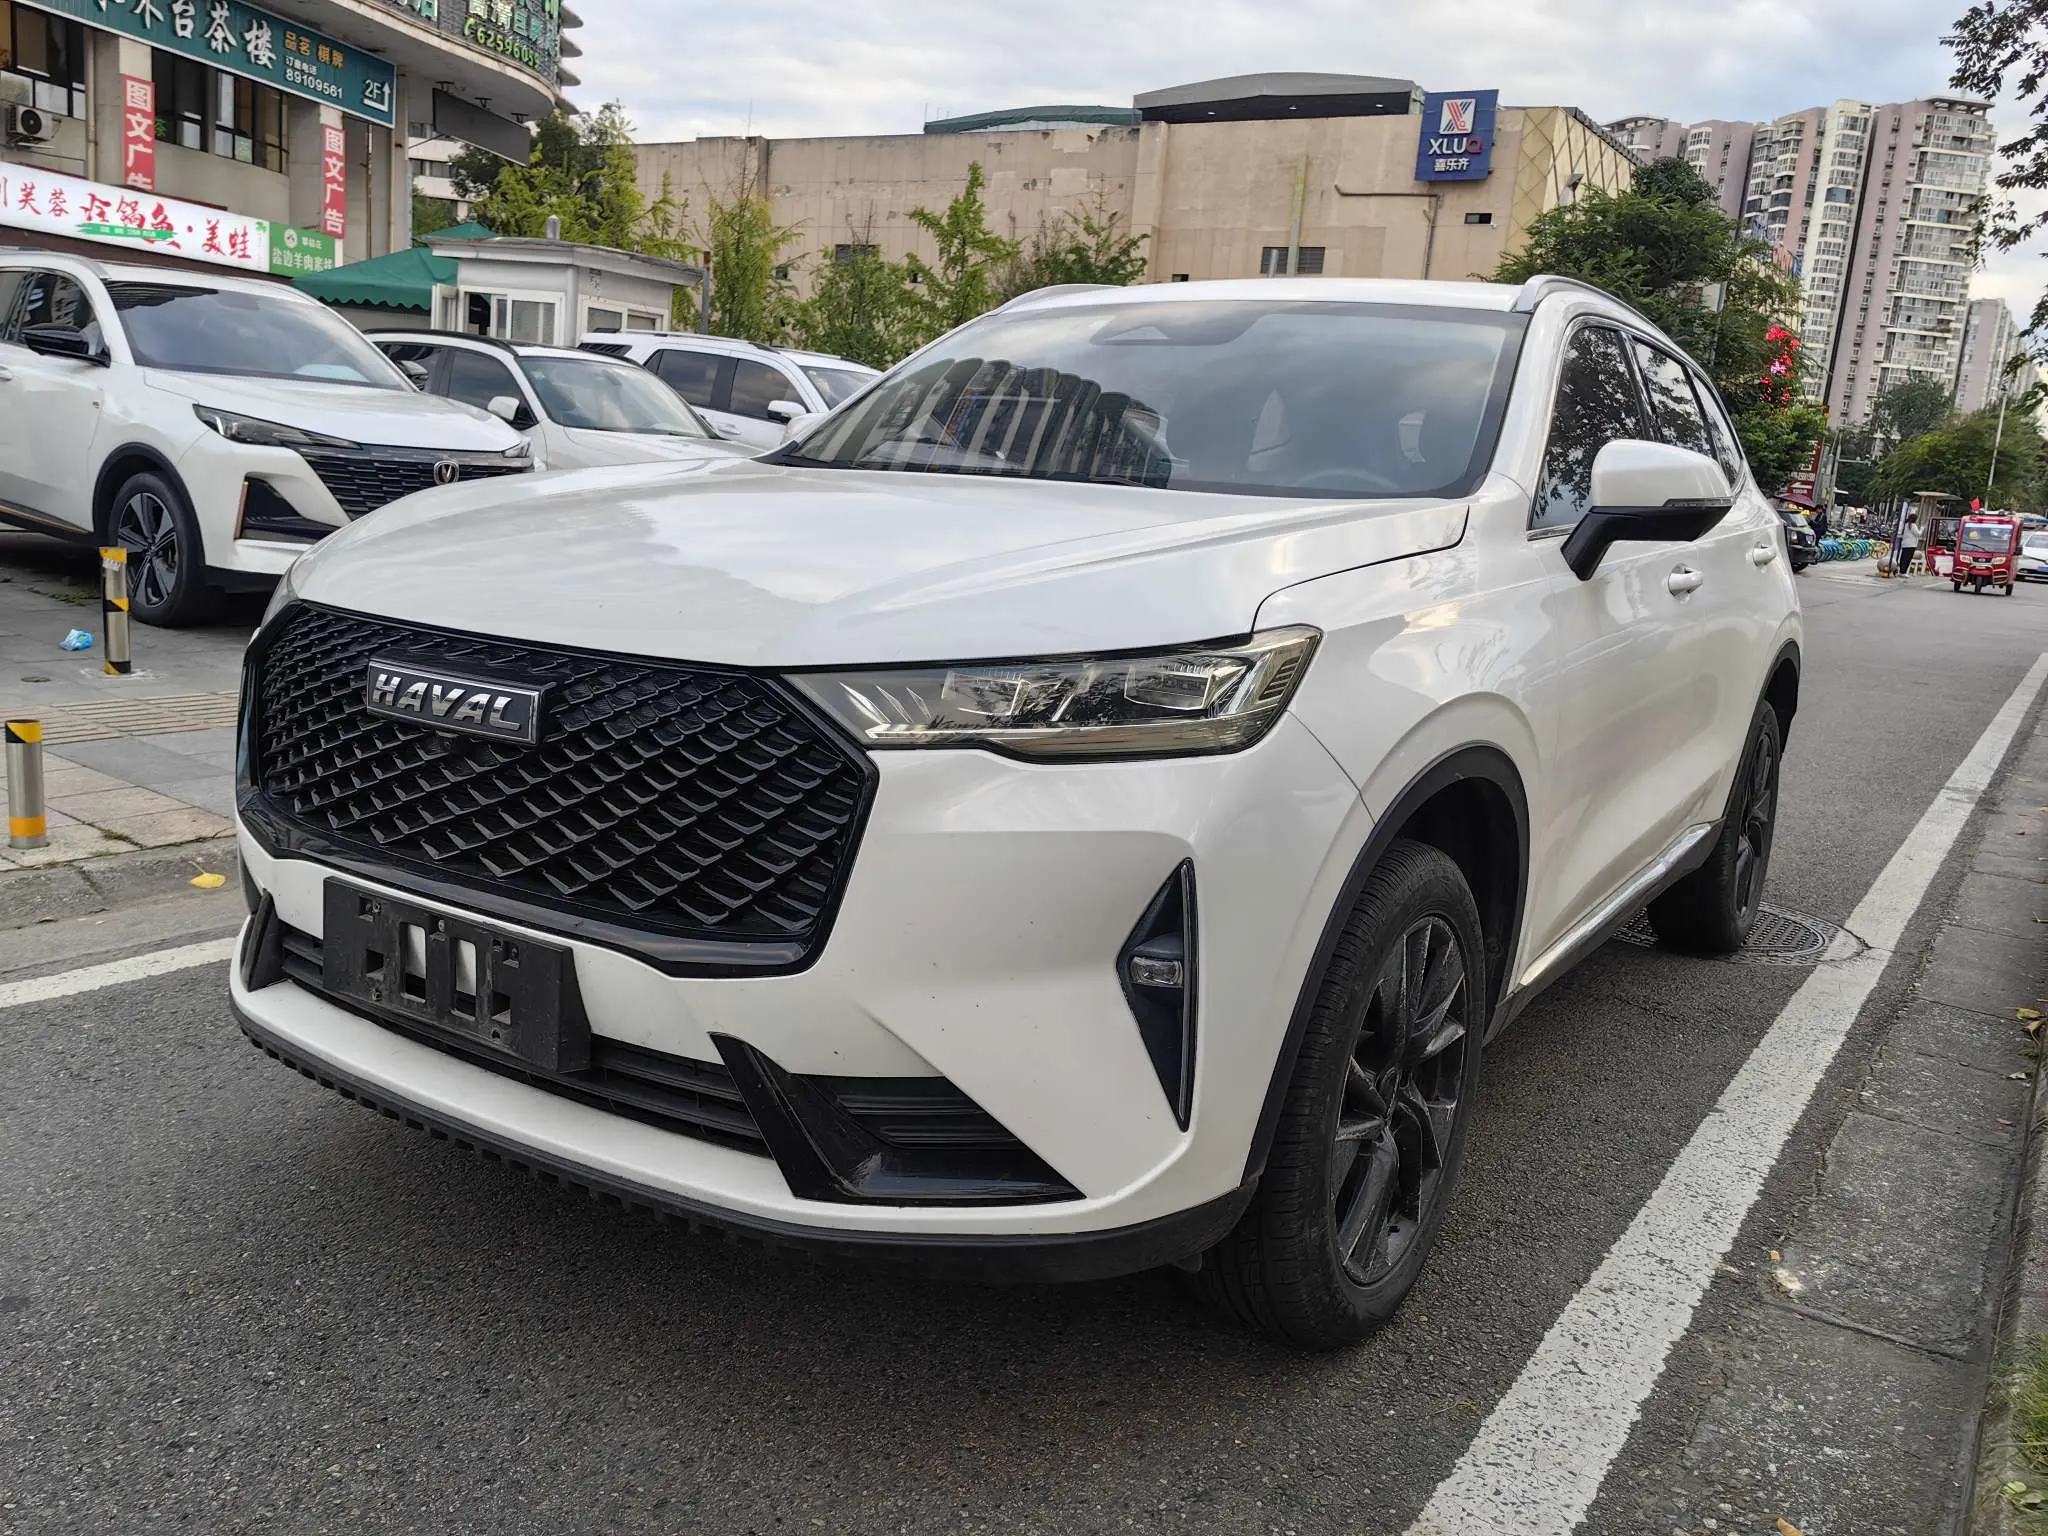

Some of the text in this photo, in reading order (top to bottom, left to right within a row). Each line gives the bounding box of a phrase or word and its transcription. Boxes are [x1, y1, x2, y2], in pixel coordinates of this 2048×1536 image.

[285, 69, 343, 99] 89109561
[364, 79, 382, 99] 2F
[324, 127, 345, 235] 图文广告
[371, 673, 521, 731] HAVAL
